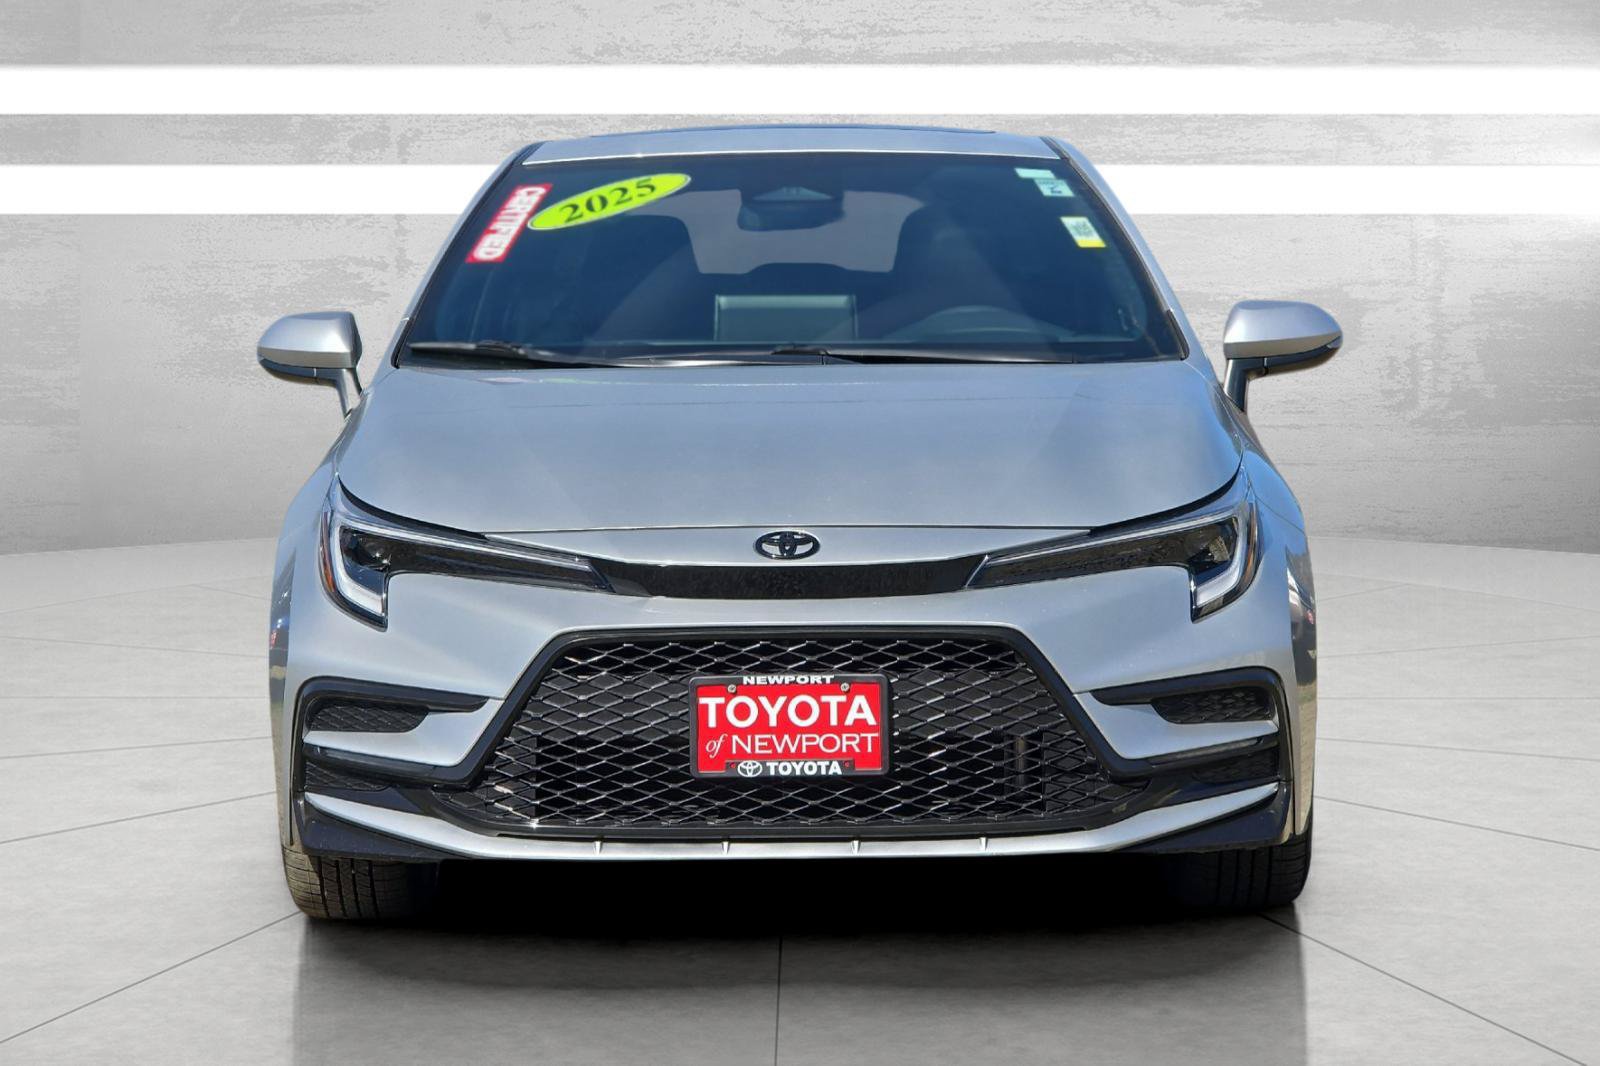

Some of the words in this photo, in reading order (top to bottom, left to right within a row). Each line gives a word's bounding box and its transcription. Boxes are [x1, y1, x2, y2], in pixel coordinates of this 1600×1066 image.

[559, 178, 656, 223] 2025
[473, 186, 547, 261] CERTIFIED
[742, 675, 835, 686] NEWPORT
[698, 694, 877, 728] TOYOTA
[705, 733, 727, 759] of
[731, 733, 879, 754] NEWPORT
[765, 761, 843, 776] TOYOTA
